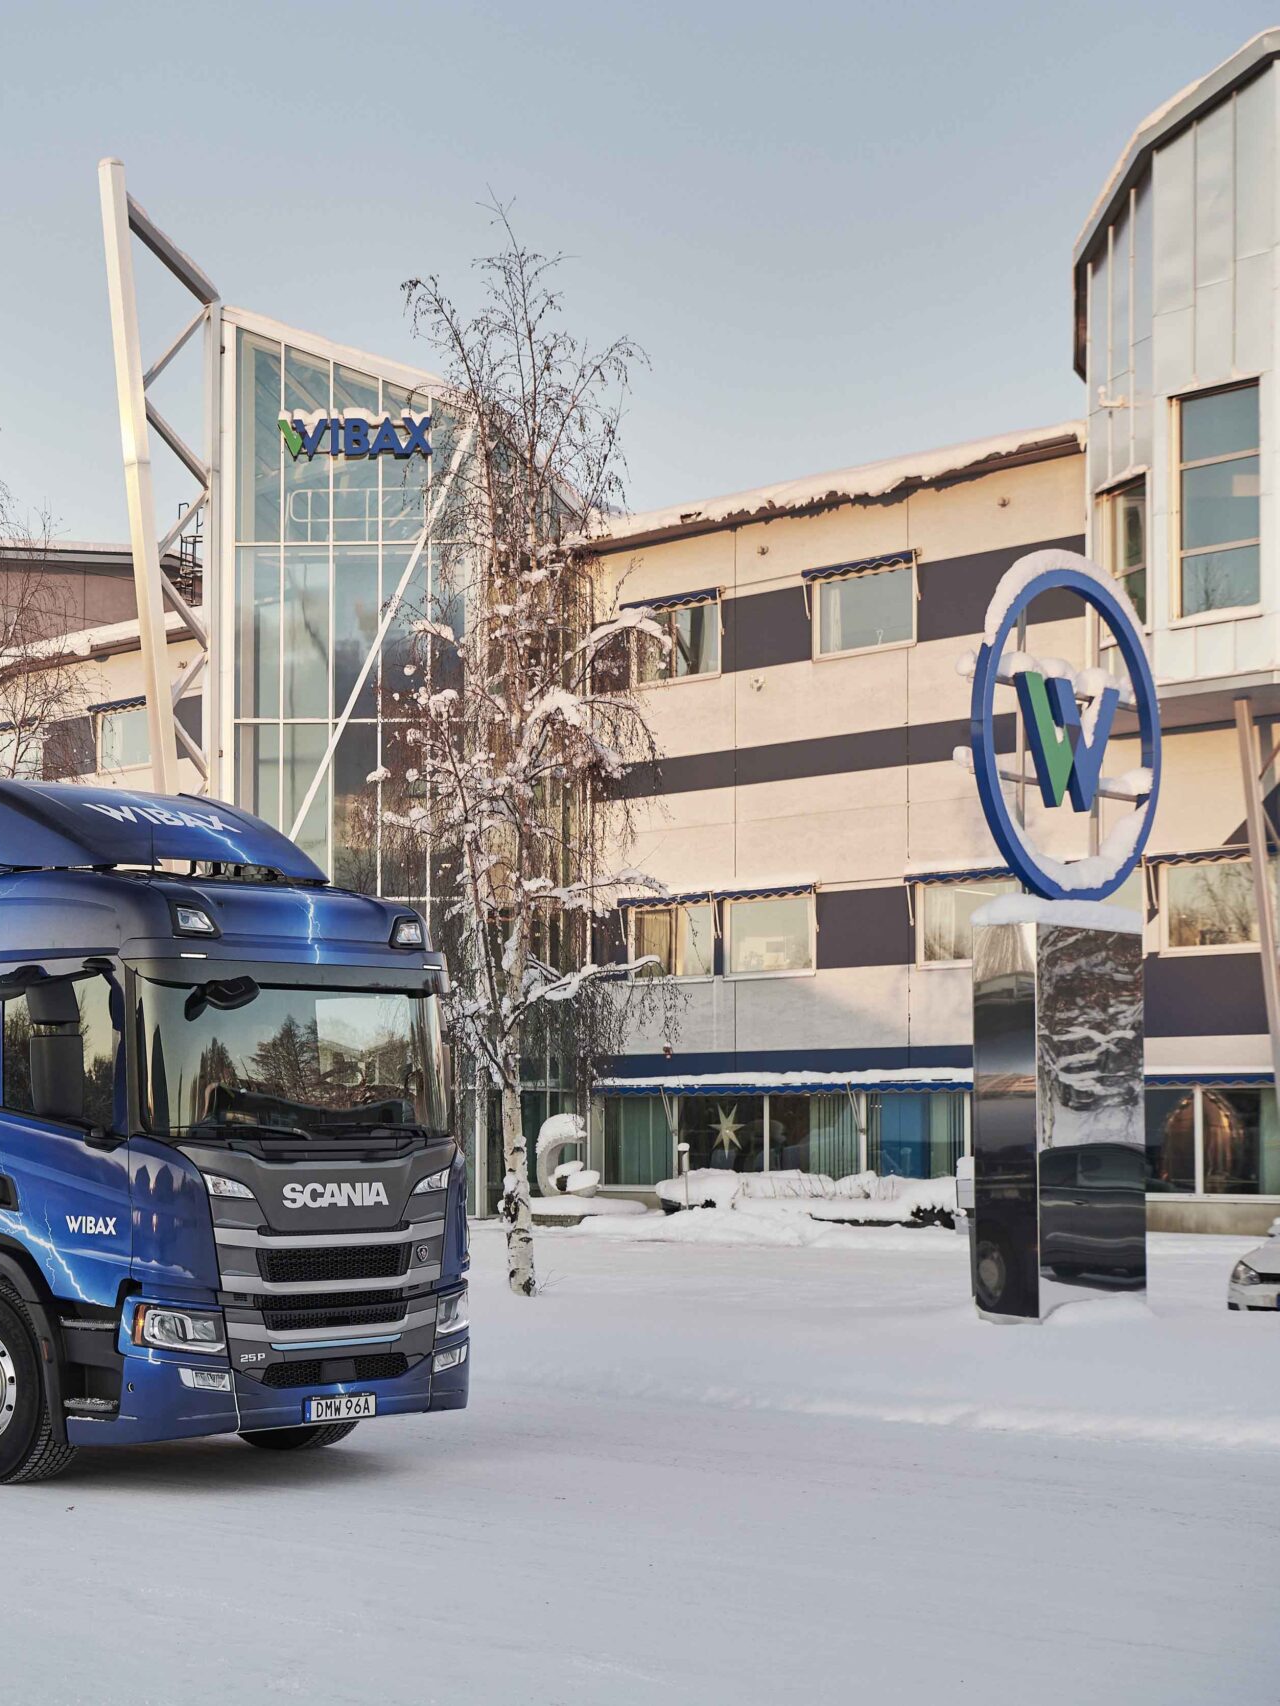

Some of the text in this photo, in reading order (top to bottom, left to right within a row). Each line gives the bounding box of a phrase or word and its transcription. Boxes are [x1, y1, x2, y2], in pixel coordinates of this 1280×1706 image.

[278, 416, 433, 461] WIBAX
[82, 803, 242, 833] WIBAX
[282, 1182, 389, 1208] SCANIA
[65, 1215, 117, 1235] WIBAX
[316, 1397, 370, 1418] DMW 96A
